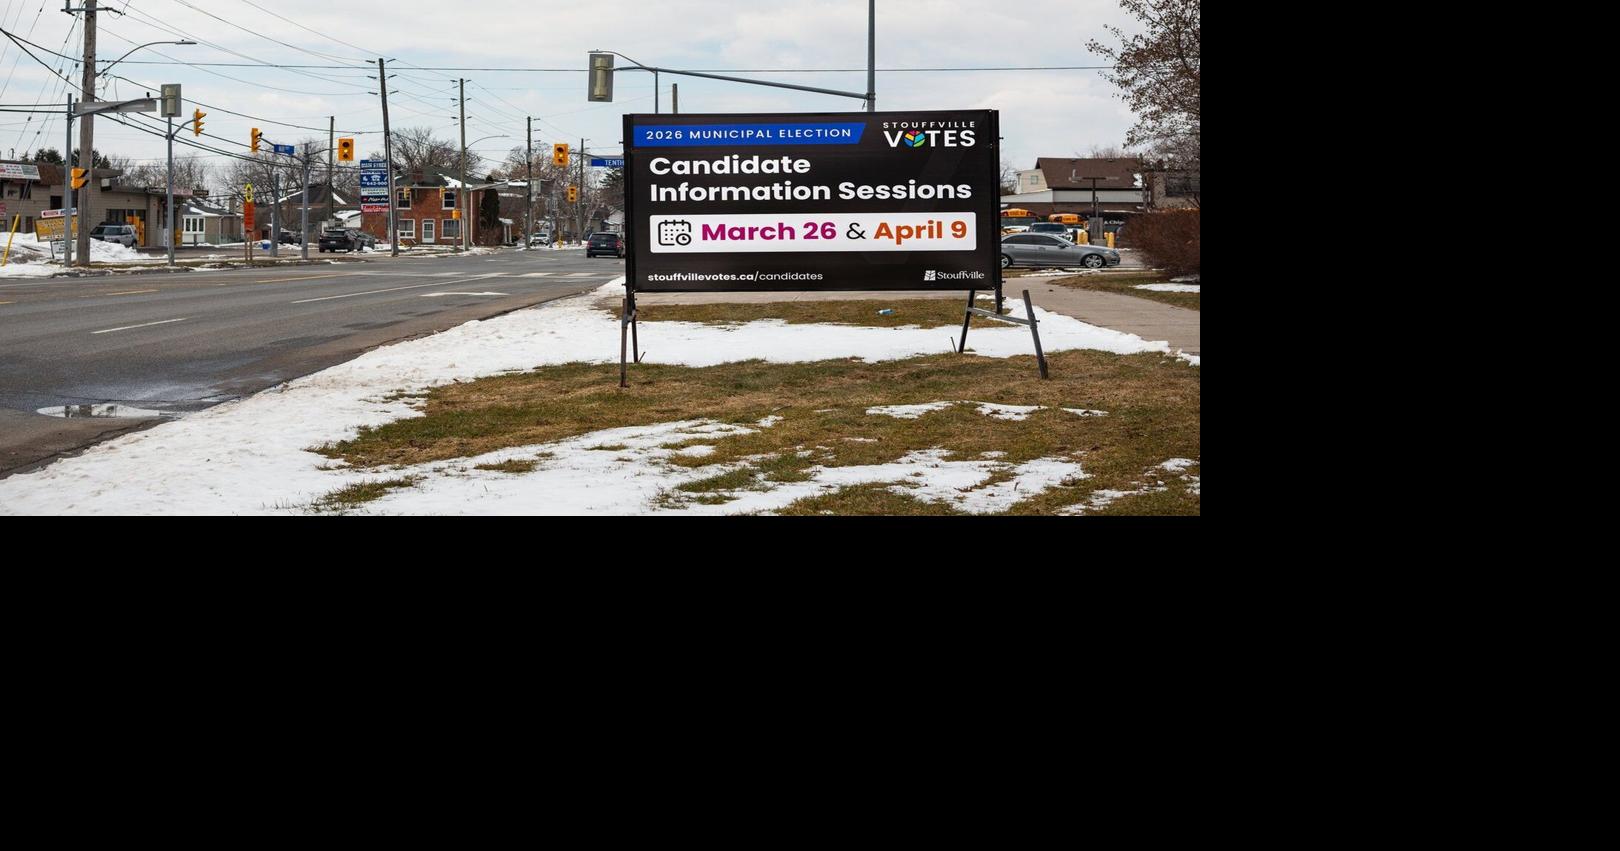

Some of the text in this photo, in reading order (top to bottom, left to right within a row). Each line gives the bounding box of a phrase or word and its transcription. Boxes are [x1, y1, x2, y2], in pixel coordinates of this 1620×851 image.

[883, 121, 976, 129] STOUFFVILLE
[646, 128, 851, 140] 2026 MUNICIPAL ELECTION
[649, 154, 811, 175] Candidate
[650, 179, 972, 202] Information Sessions
[702, 219, 967, 245] March 26 & April 9
[647, 271, 824, 282] stouffvillevotes.ca/candidates
[936, 270, 985, 280] Stouffville
